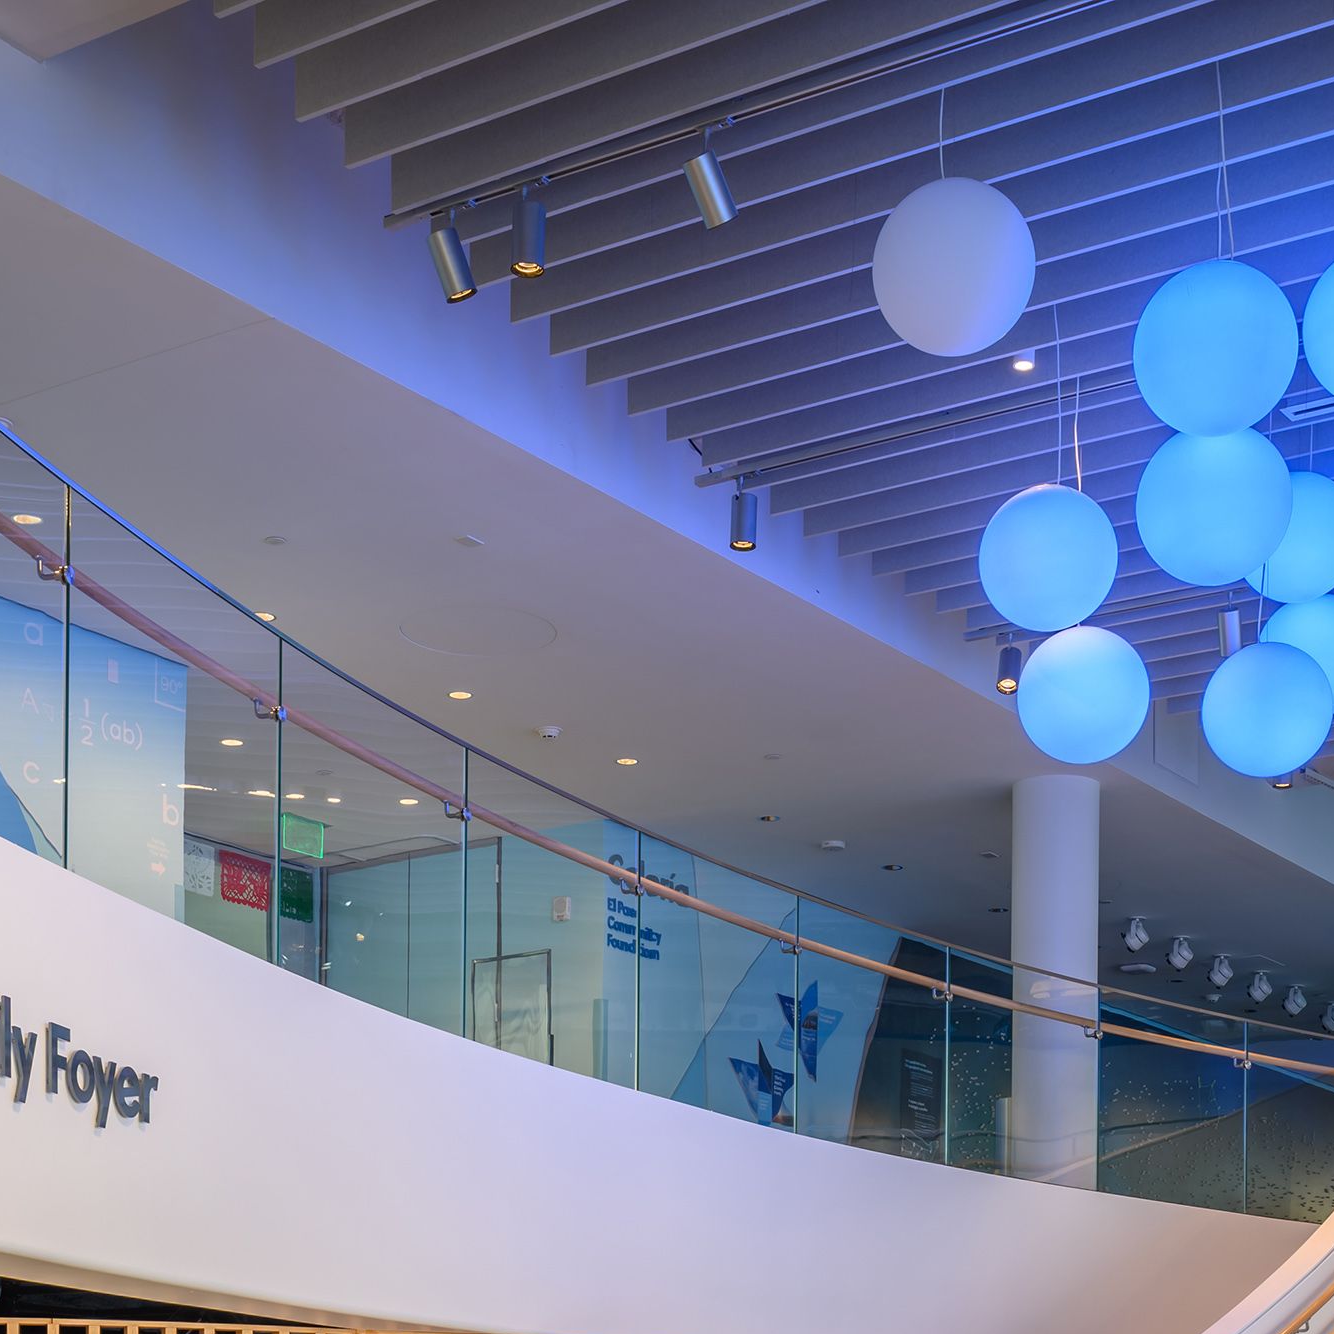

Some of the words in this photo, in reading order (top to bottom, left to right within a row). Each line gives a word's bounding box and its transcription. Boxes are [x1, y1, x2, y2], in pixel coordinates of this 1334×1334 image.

[607, 897, 617, 912] El
[607, 915, 662, 946] Commnity
[607, 933, 660, 960] Foundion
[45, 1021, 159, 1129] Foyer
